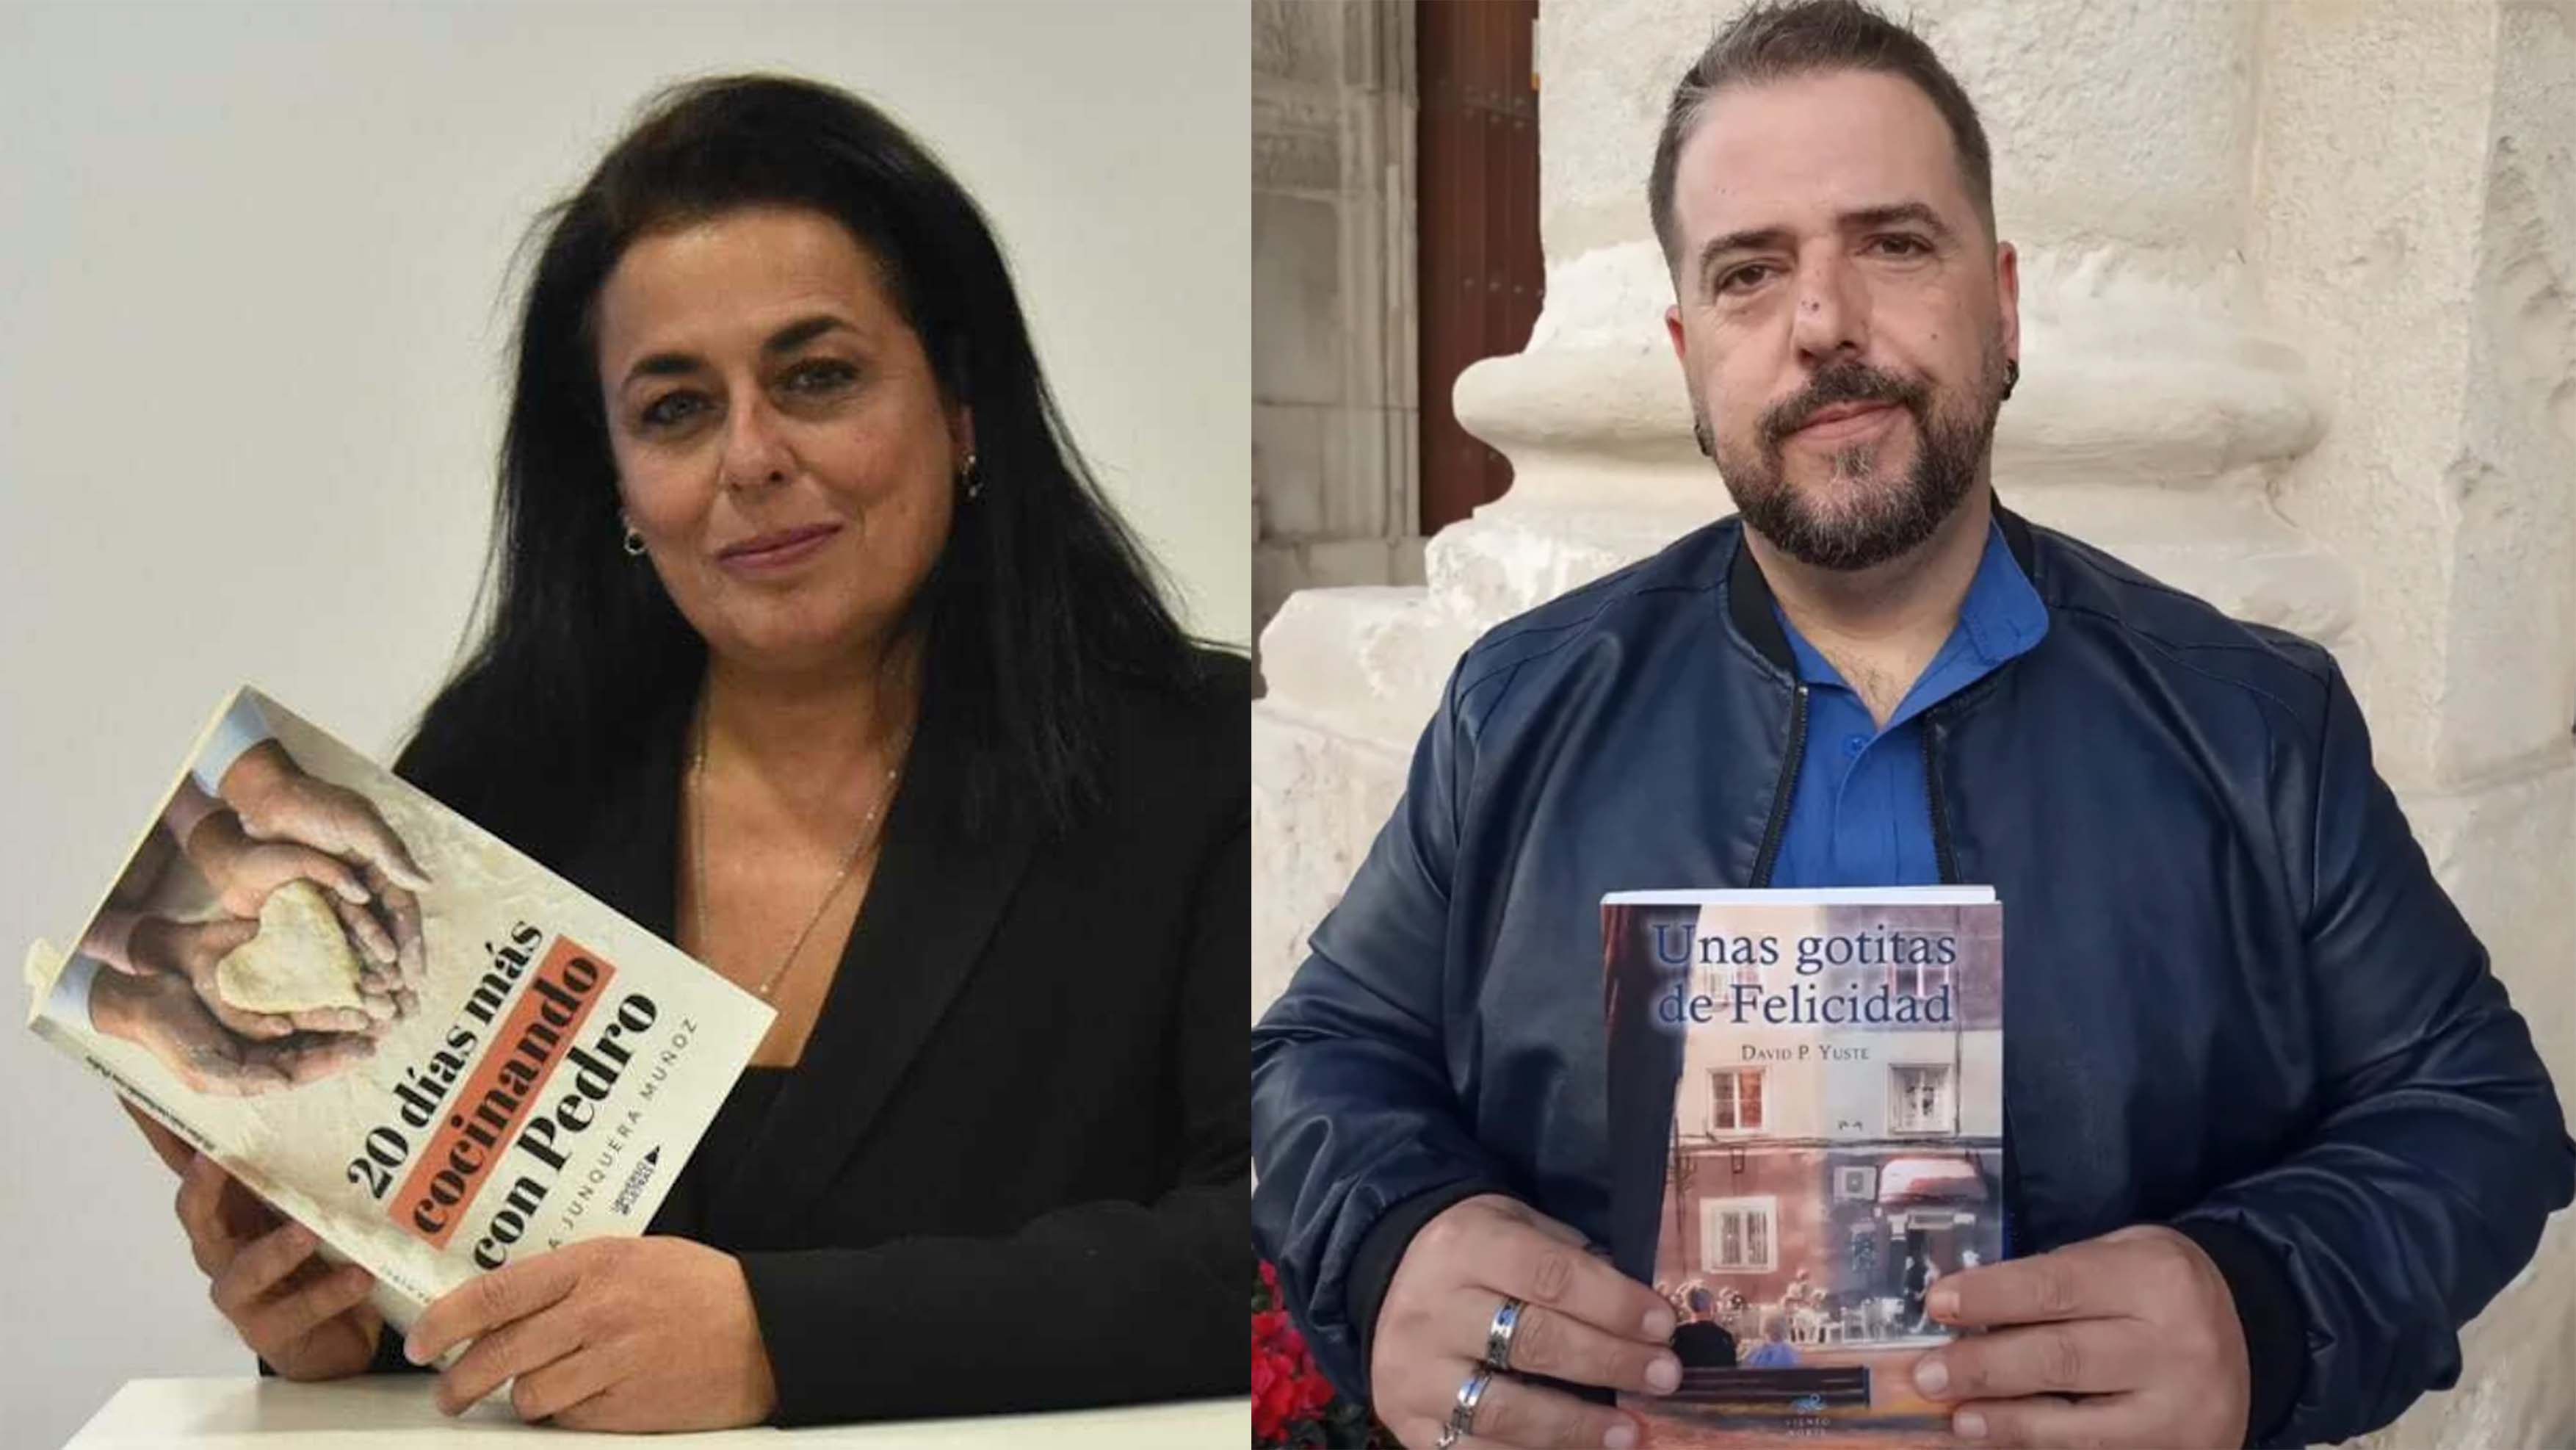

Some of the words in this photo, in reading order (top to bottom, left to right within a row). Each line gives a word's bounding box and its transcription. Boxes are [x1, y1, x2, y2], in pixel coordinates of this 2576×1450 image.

[1652, 924, 1779, 964] Unas
[1795, 923, 1956, 975] gotitas
[1657, 984, 1713, 1023] de
[1730, 983, 1952, 1024] Felicidad
[1741, 1044, 1792, 1061] DAVID
[1819, 1044, 1870, 1061] YUSTE
[346, 1126, 409, 1200] 20
[393, 1025, 478, 1129] días
[464, 920, 543, 1025] más
[413, 956, 599, 1235] cocinando
[474, 1177, 549, 1270] con
[516, 993, 658, 1172] Pedro
[562, 1110, 641, 1229] JUNQUERA
[640, 1019, 698, 1101] MUÑOZ
